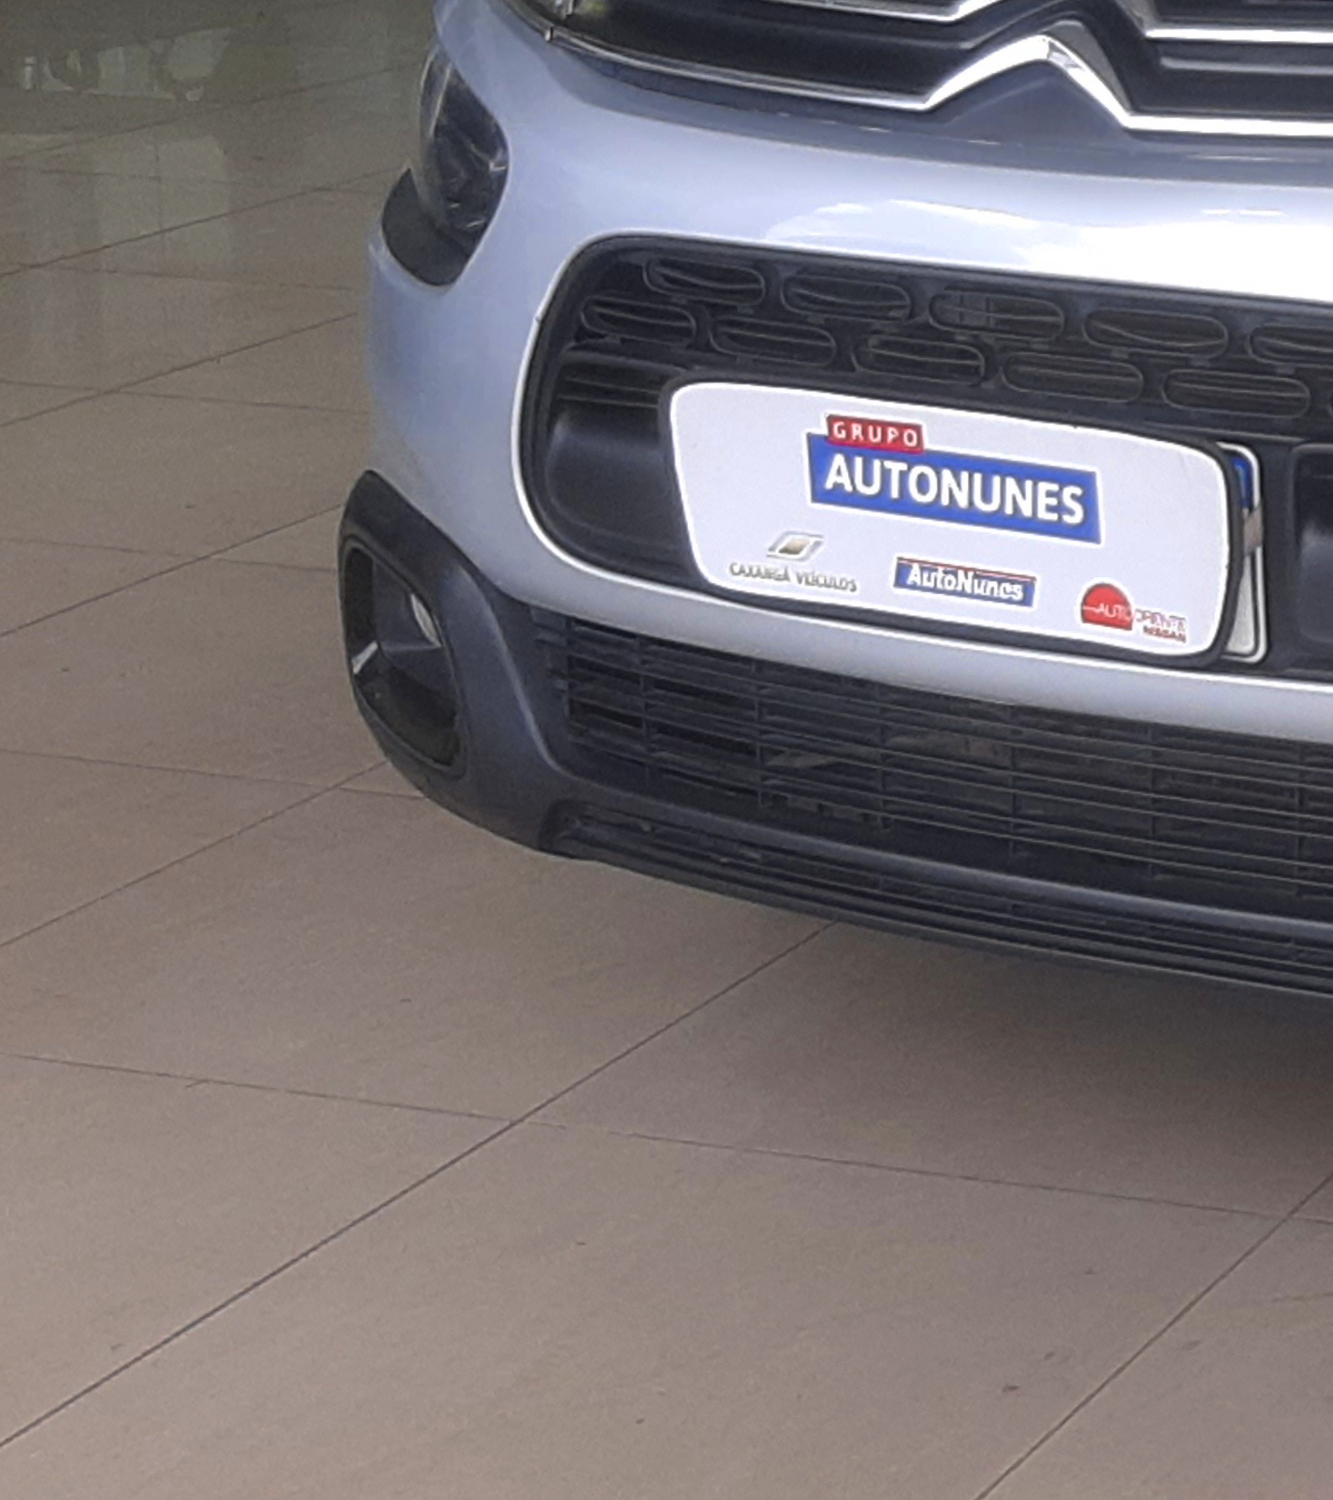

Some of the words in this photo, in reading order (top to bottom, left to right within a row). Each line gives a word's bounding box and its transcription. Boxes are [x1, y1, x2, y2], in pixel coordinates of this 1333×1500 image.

[832, 419, 919, 448] GRUPO
[824, 453, 1085, 526] AUTONUNES
[906, 563, 1024, 601] AutoNunes
